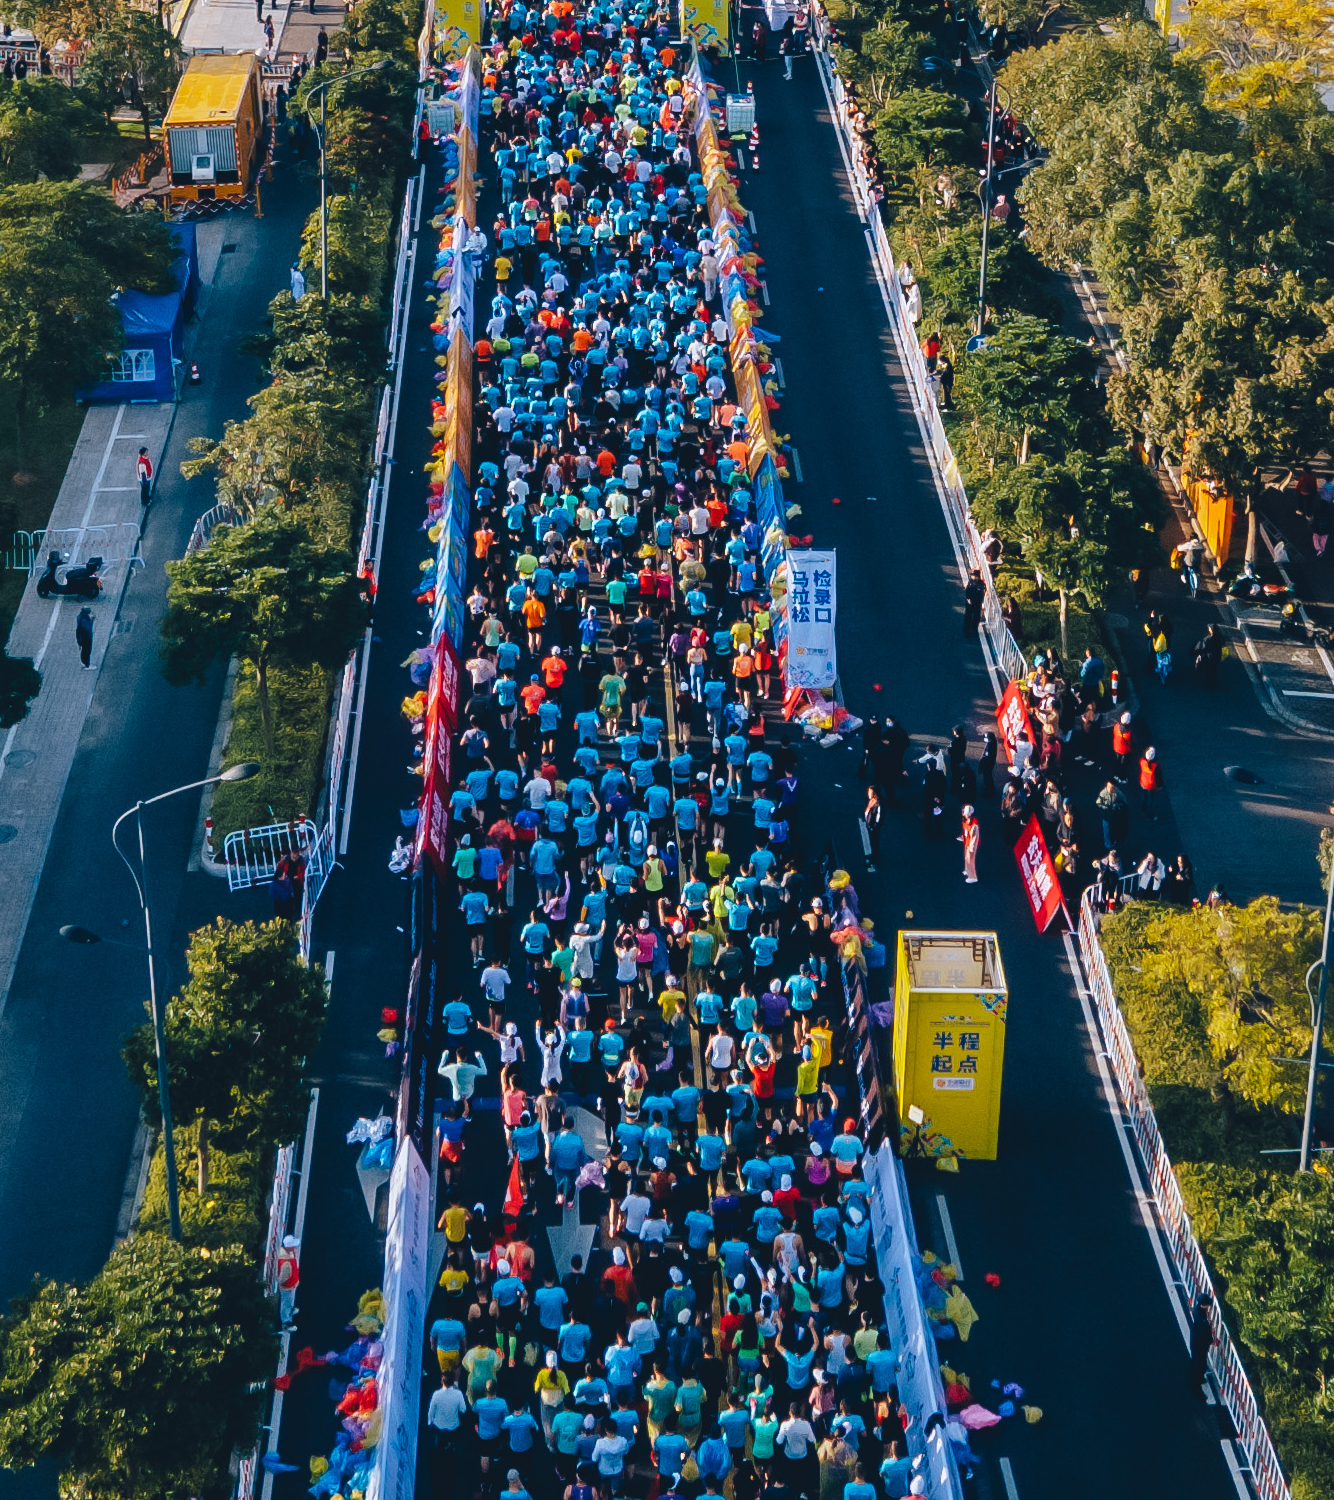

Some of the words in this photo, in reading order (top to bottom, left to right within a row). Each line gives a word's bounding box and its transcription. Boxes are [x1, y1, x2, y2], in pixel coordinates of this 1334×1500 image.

[792, 570, 810, 623] 马拉松
[813, 569, 832, 623] 检录口
[933, 1031, 980, 1050] 半程
[931, 1054, 978, 1073] 起点
